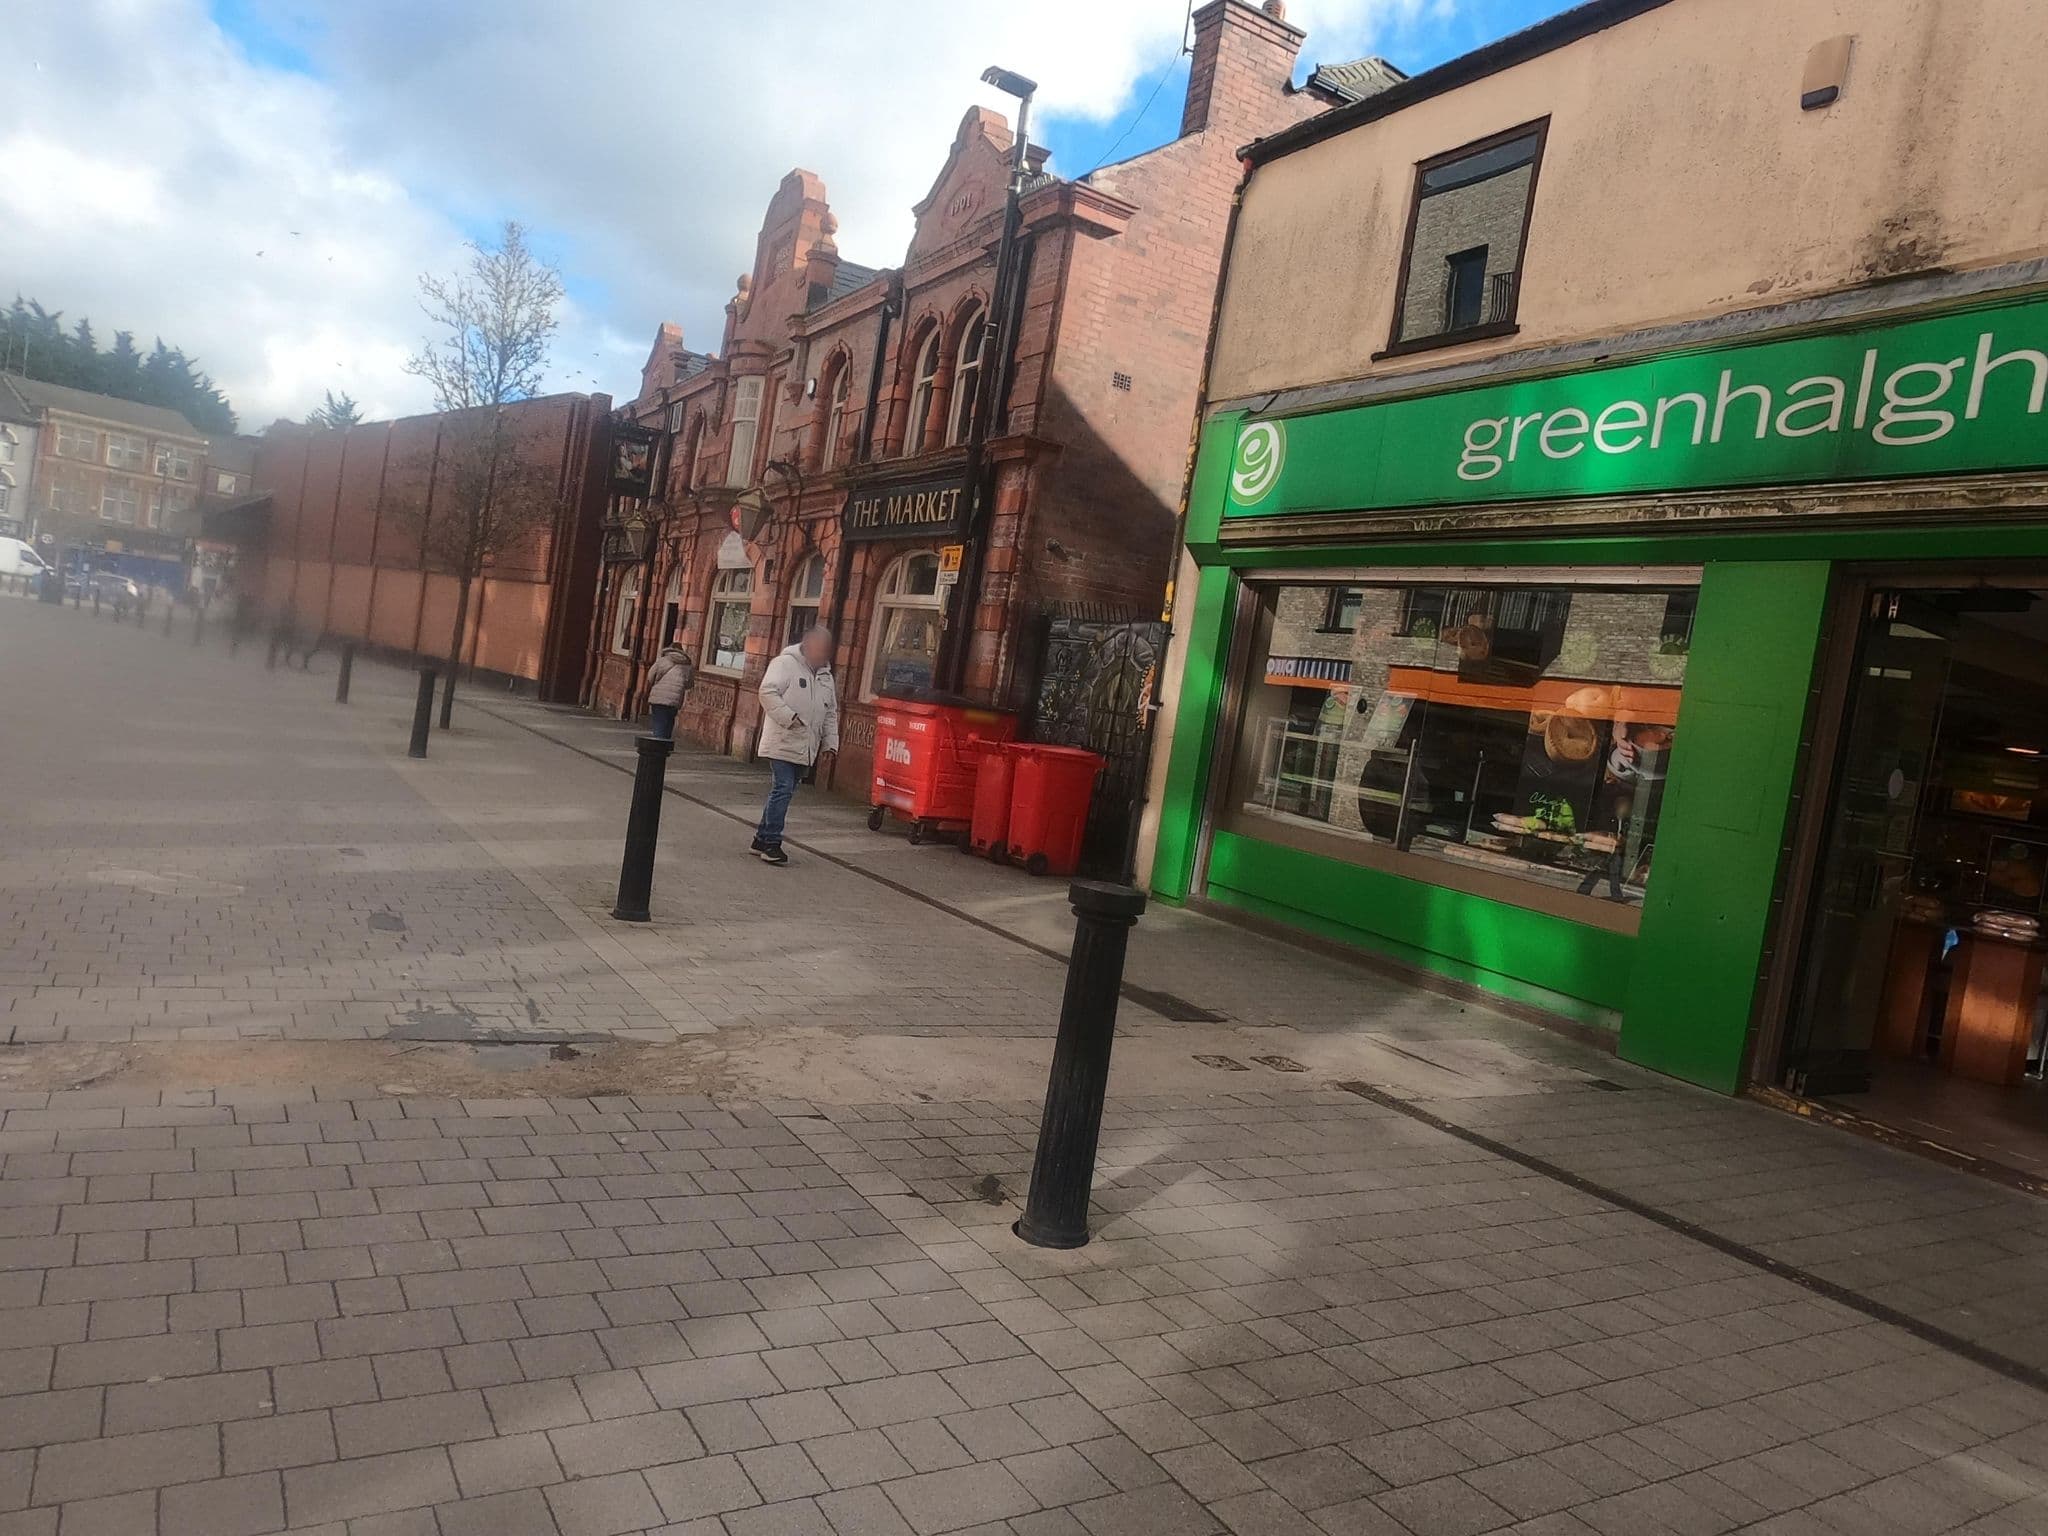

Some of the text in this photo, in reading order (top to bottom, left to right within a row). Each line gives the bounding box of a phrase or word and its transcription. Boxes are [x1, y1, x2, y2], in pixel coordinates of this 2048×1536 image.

[1455, 331, 2048, 482] greenhalgh
[853, 488, 961, 528] THE MARKET
[844, 719, 875, 748] MARKE
[885, 737, 911, 765] Biffa
